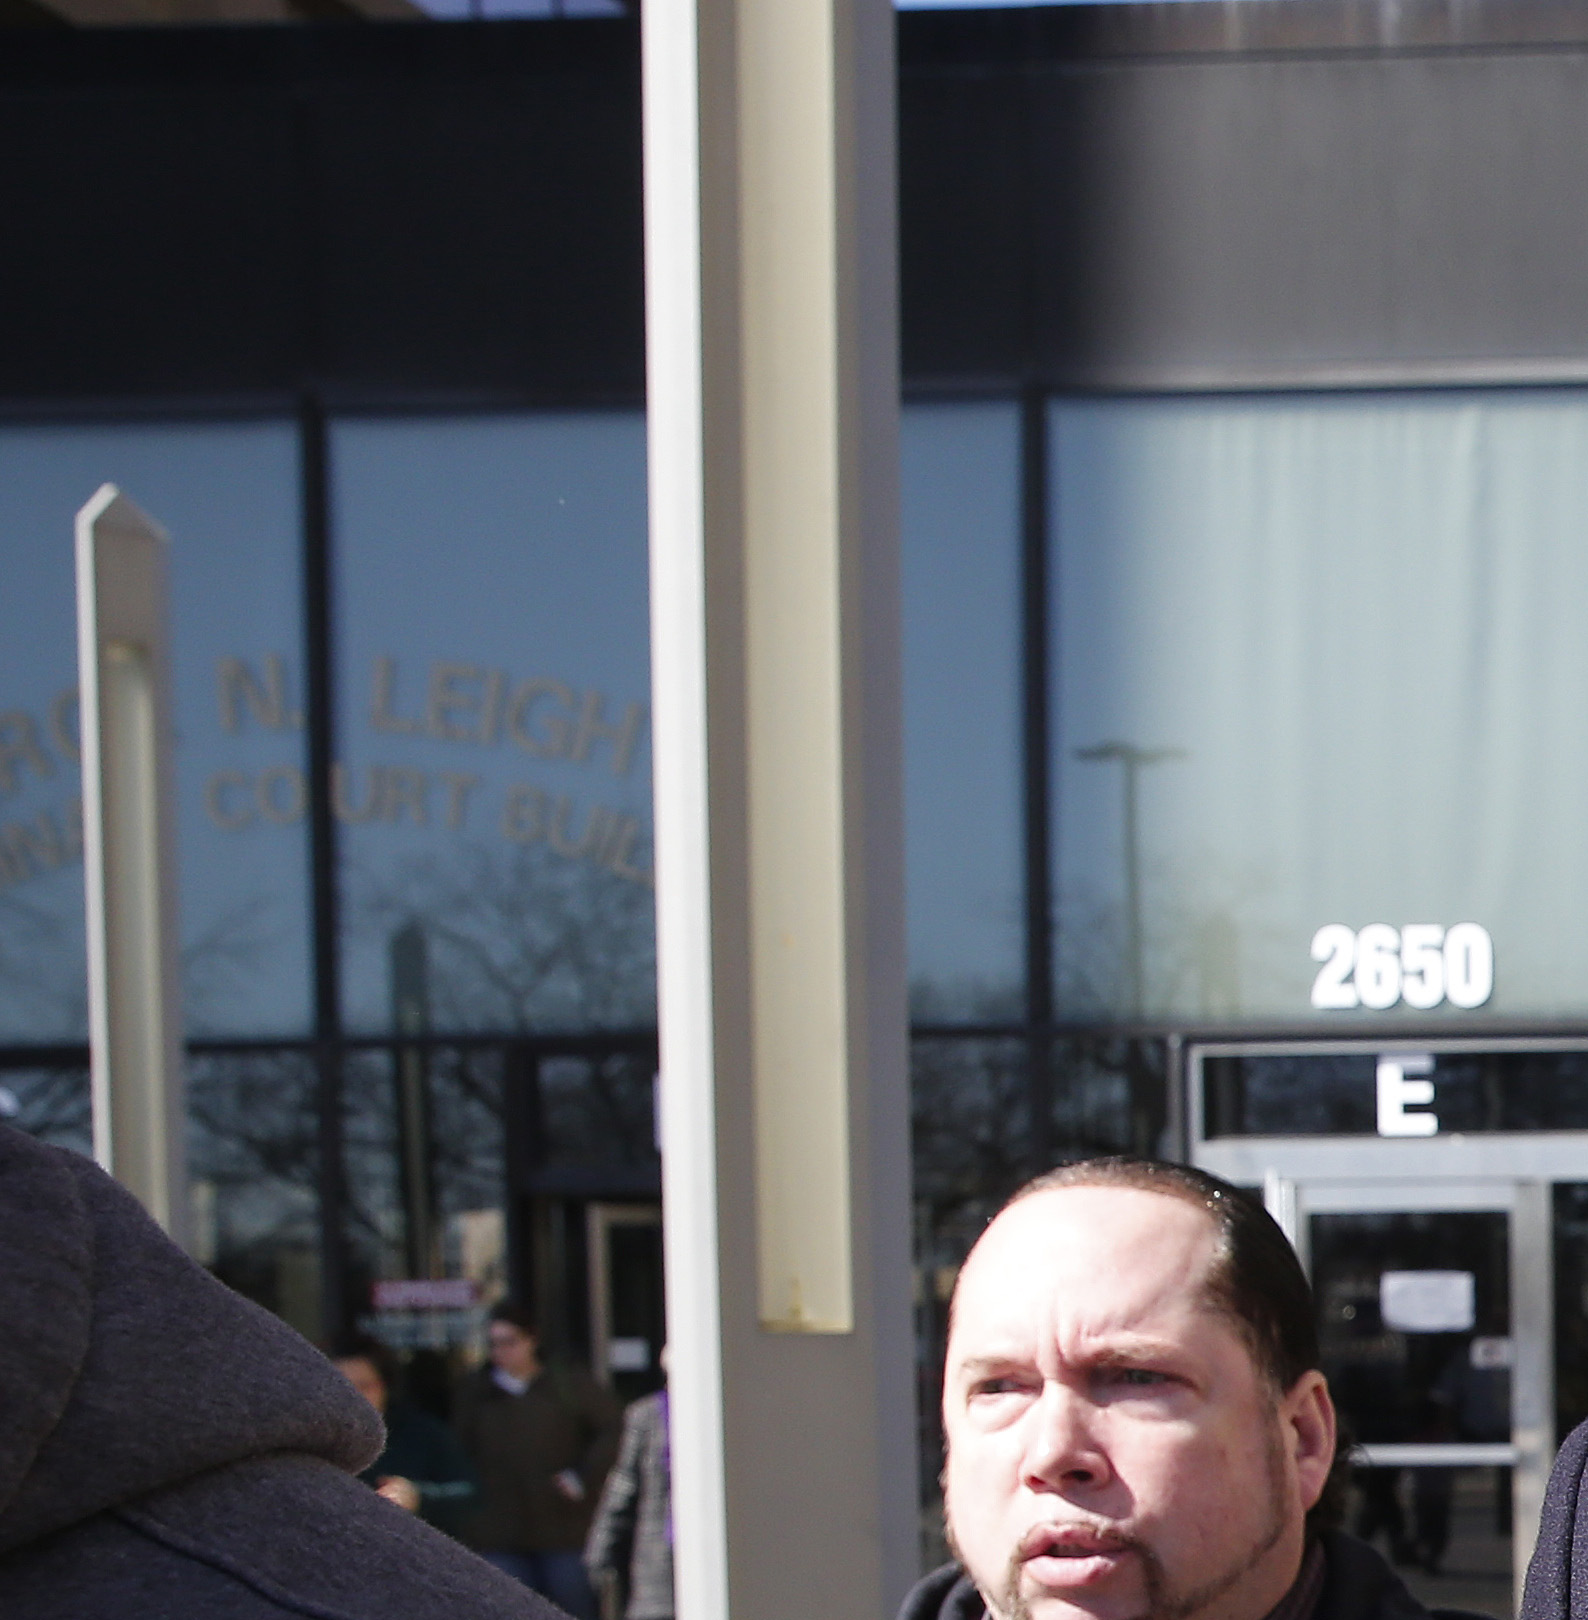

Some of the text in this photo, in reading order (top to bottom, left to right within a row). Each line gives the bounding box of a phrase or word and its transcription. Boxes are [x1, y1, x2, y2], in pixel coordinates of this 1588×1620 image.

[204, 763, 481, 834] COURT
[1310, 922, 1494, 1009] 2650
[1376, 1053, 1439, 1137] E
